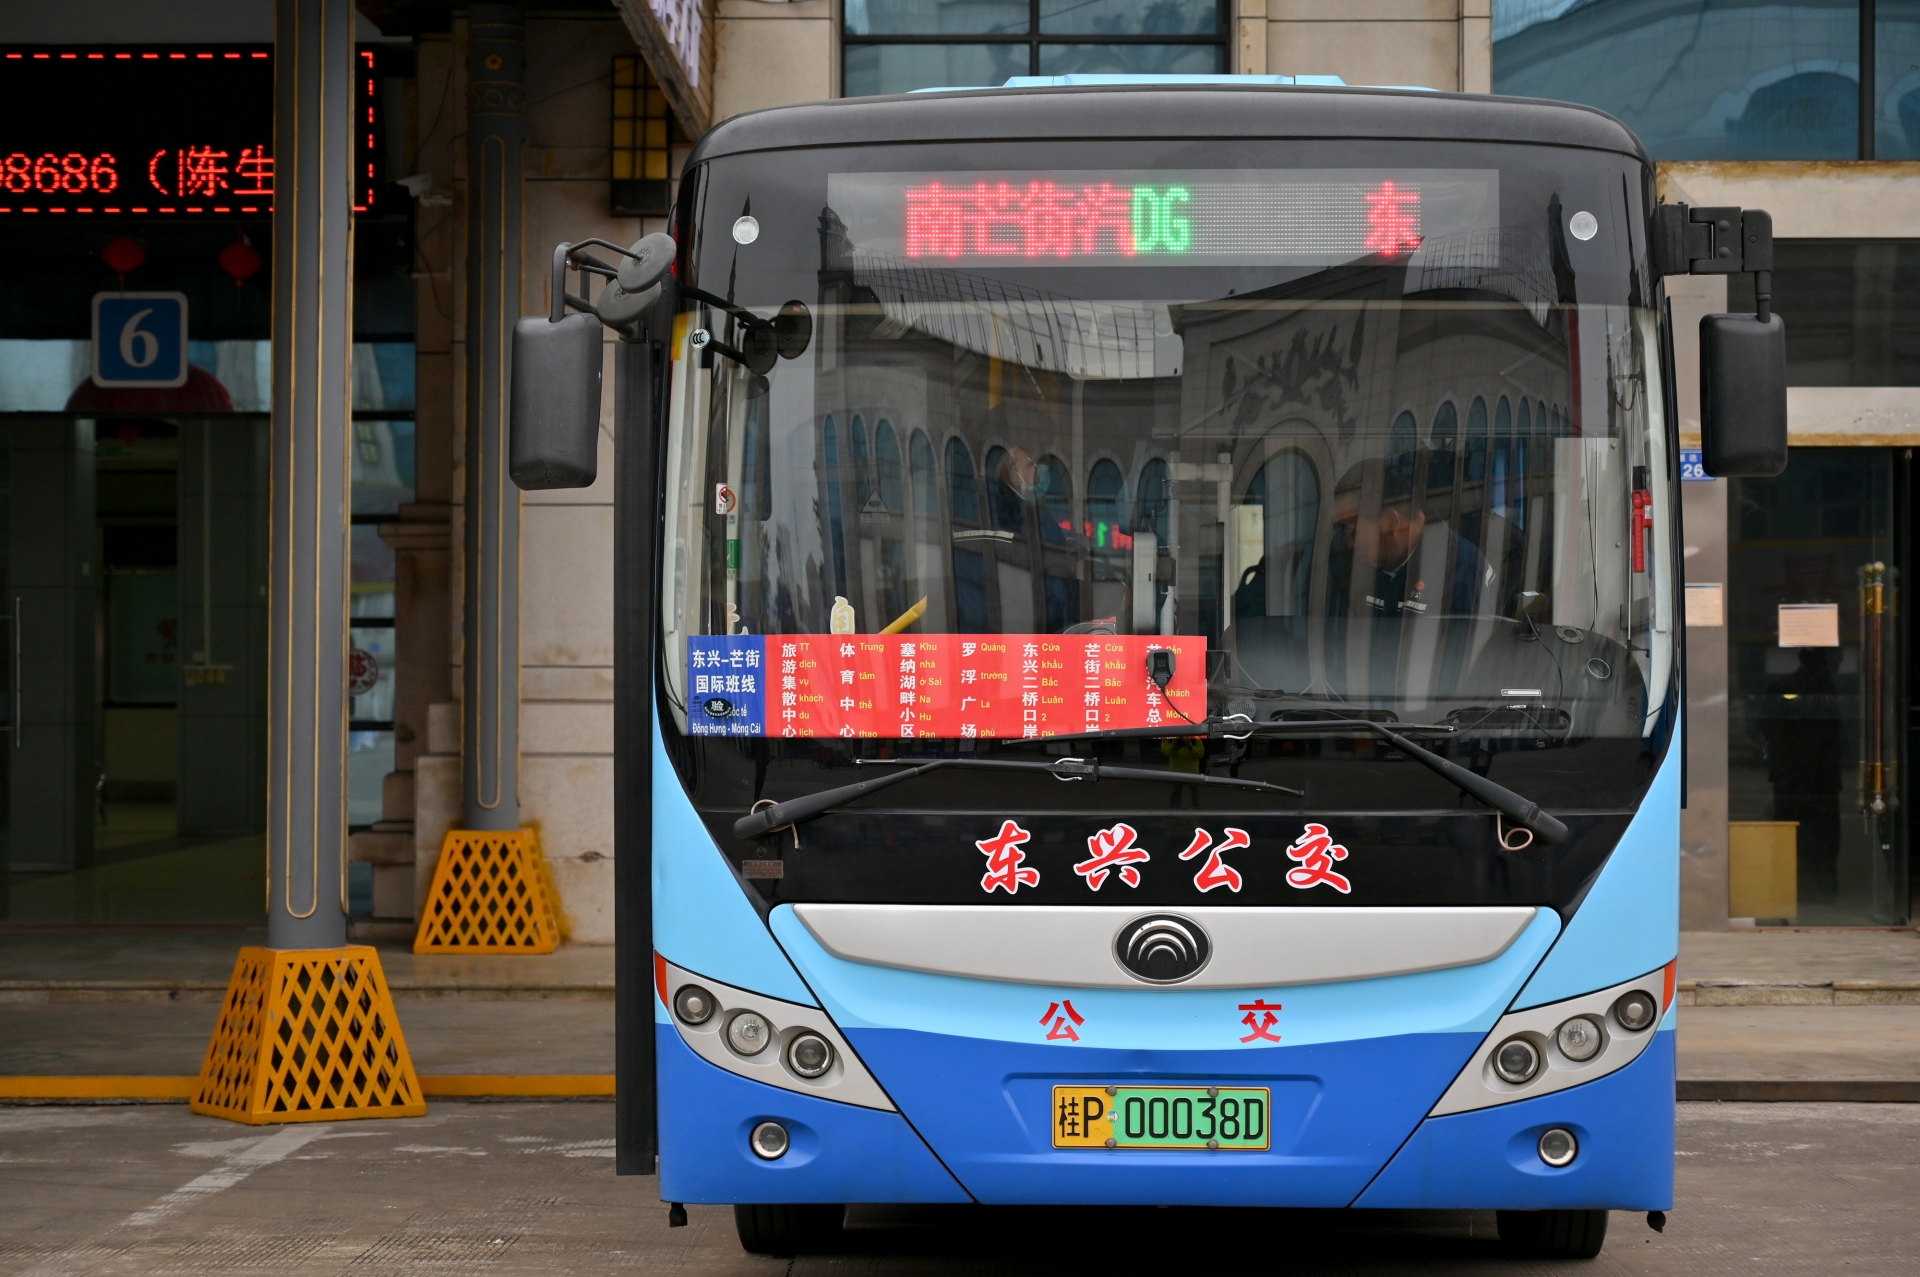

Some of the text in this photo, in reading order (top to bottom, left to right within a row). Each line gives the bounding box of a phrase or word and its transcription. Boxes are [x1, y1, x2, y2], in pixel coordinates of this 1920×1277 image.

[0, 153, 118, 193] 8686
[119, 307, 159, 368] 6
[799, 642, 810, 651] TT
[859, 642, 884, 652] Trung
[919, 642, 938, 651] Khu
[1041, 642, 1060, 652] Cửa
[1104, 643, 1123, 652] Cửa
[692, 649, 760, 668] 东兴-芒街
[799, 660, 817, 670] dịch
[919, 660, 936, 669] nhà
[859, 671, 875, 680] tâm
[696, 674, 756, 694] 国际班线
[799, 678, 810, 687] vụ
[928, 677, 942, 686] Sai
[1041, 676, 1059, 687] Bắc
[1104, 677, 1122, 687] Bắc
[1165, 689, 1190, 697] khách
[799, 693, 824, 703] khách
[919, 695, 931, 704] Na
[1041, 695, 1064, 704] Luân
[1104, 696, 1127, 705] Luân
[711, 700, 725, 711] 验
[981, 700, 990, 708] La
[799, 710, 810, 719] du
[919, 713, 932, 721] Hu
[1041, 713, 1047, 721] 2
[1104, 713, 1110, 722] 2
[750, 722, 761, 734] Cái
[799, 728, 814, 737] lịch
[859, 730, 878, 738] thao
[919, 730, 936, 738] Pan
[975, 819, 1352, 894] 东兴公交
